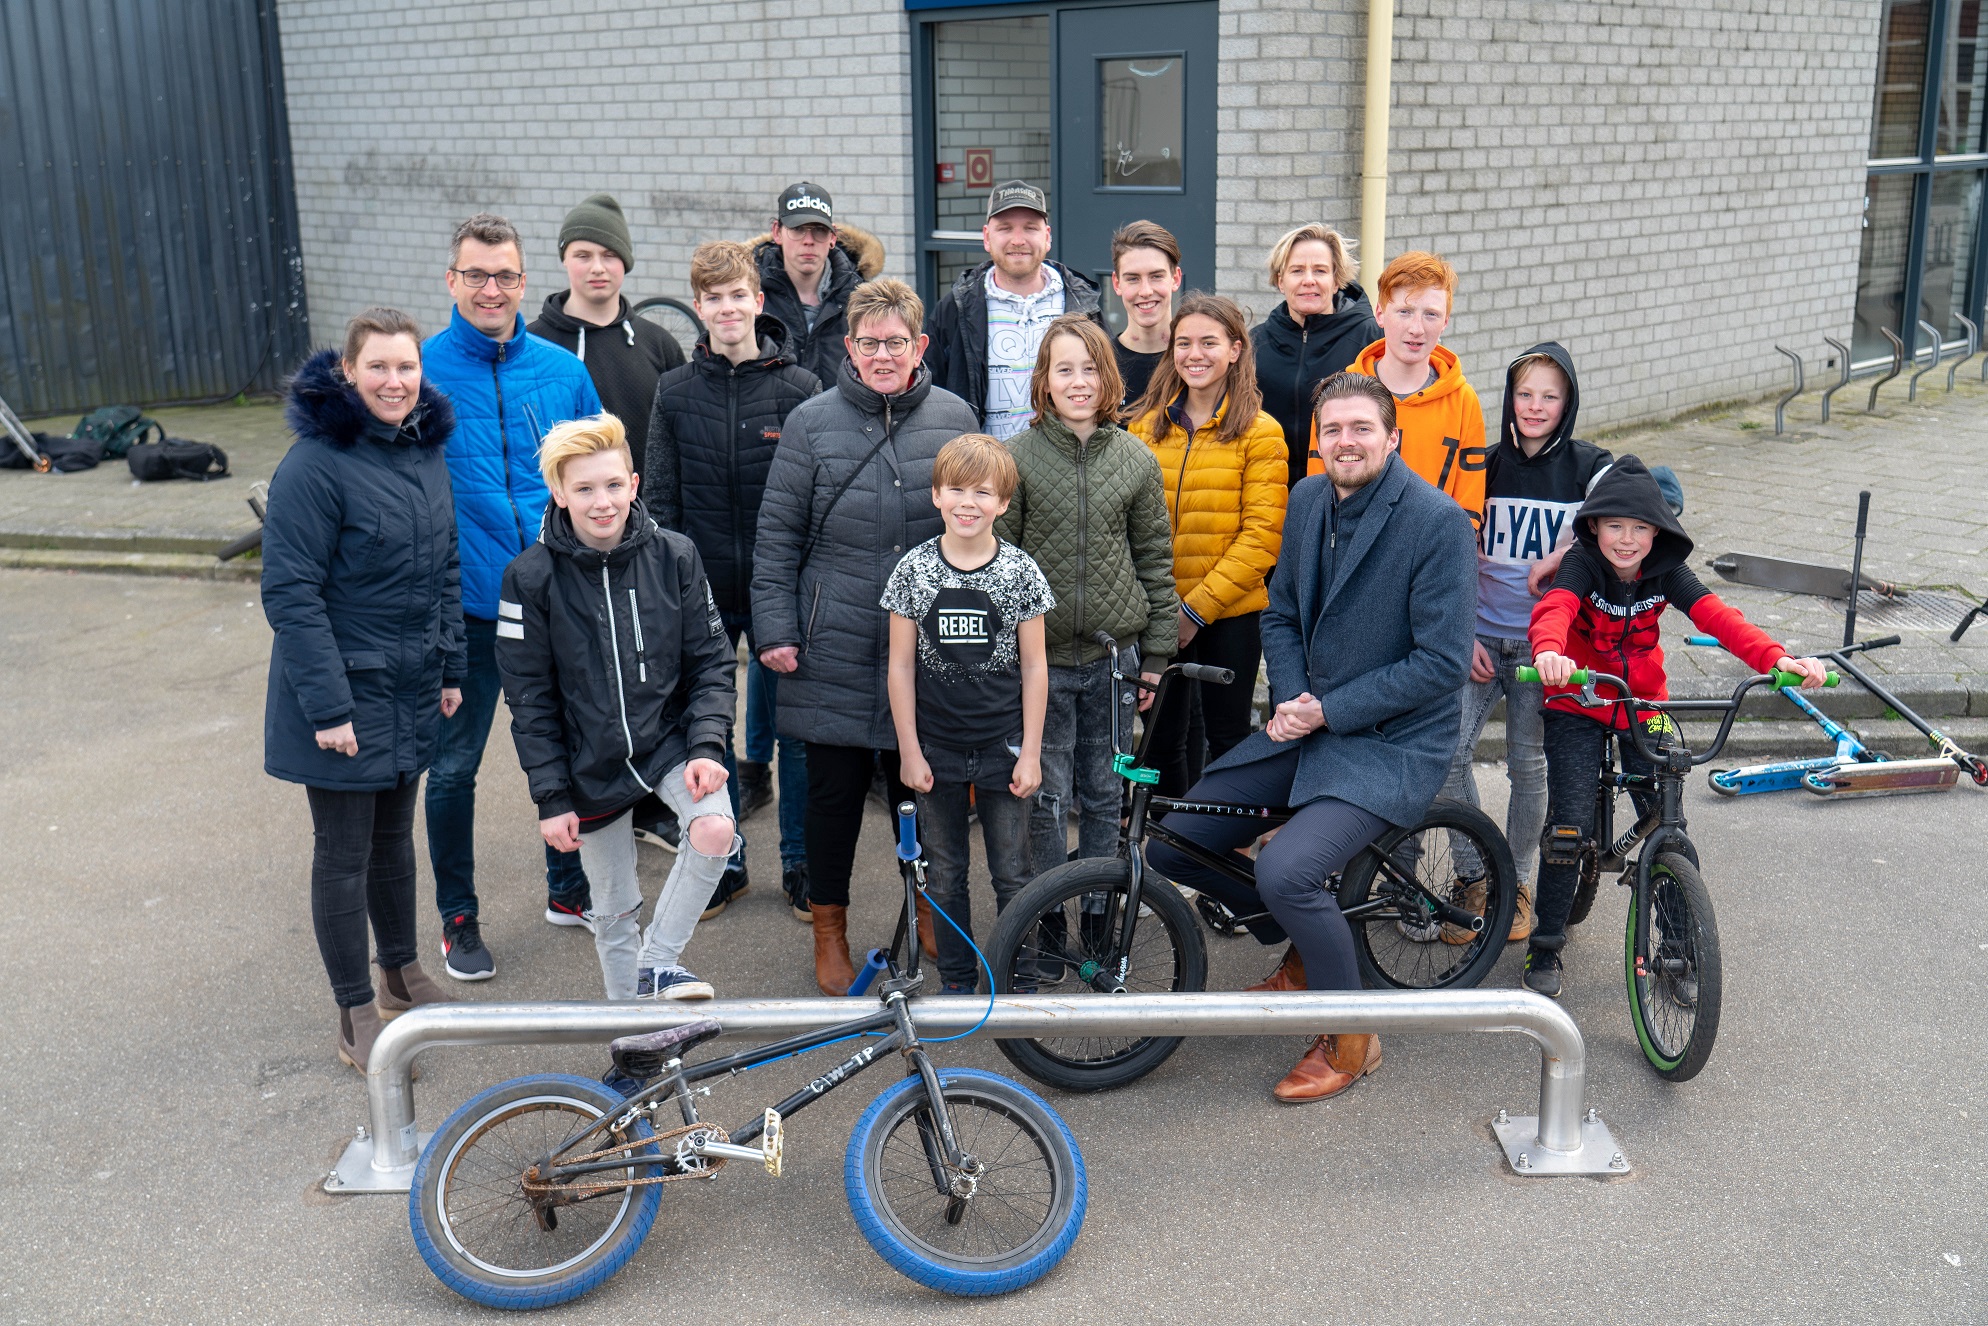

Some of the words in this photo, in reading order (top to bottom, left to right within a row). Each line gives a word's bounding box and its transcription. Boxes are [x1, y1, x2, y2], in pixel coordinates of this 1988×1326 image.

[999, 187, 1037, 201] THRASHER
[786, 195, 831, 217] adidas
[938, 615, 988, 636] REBEL
[1172, 802, 1255, 816] DIVISION
